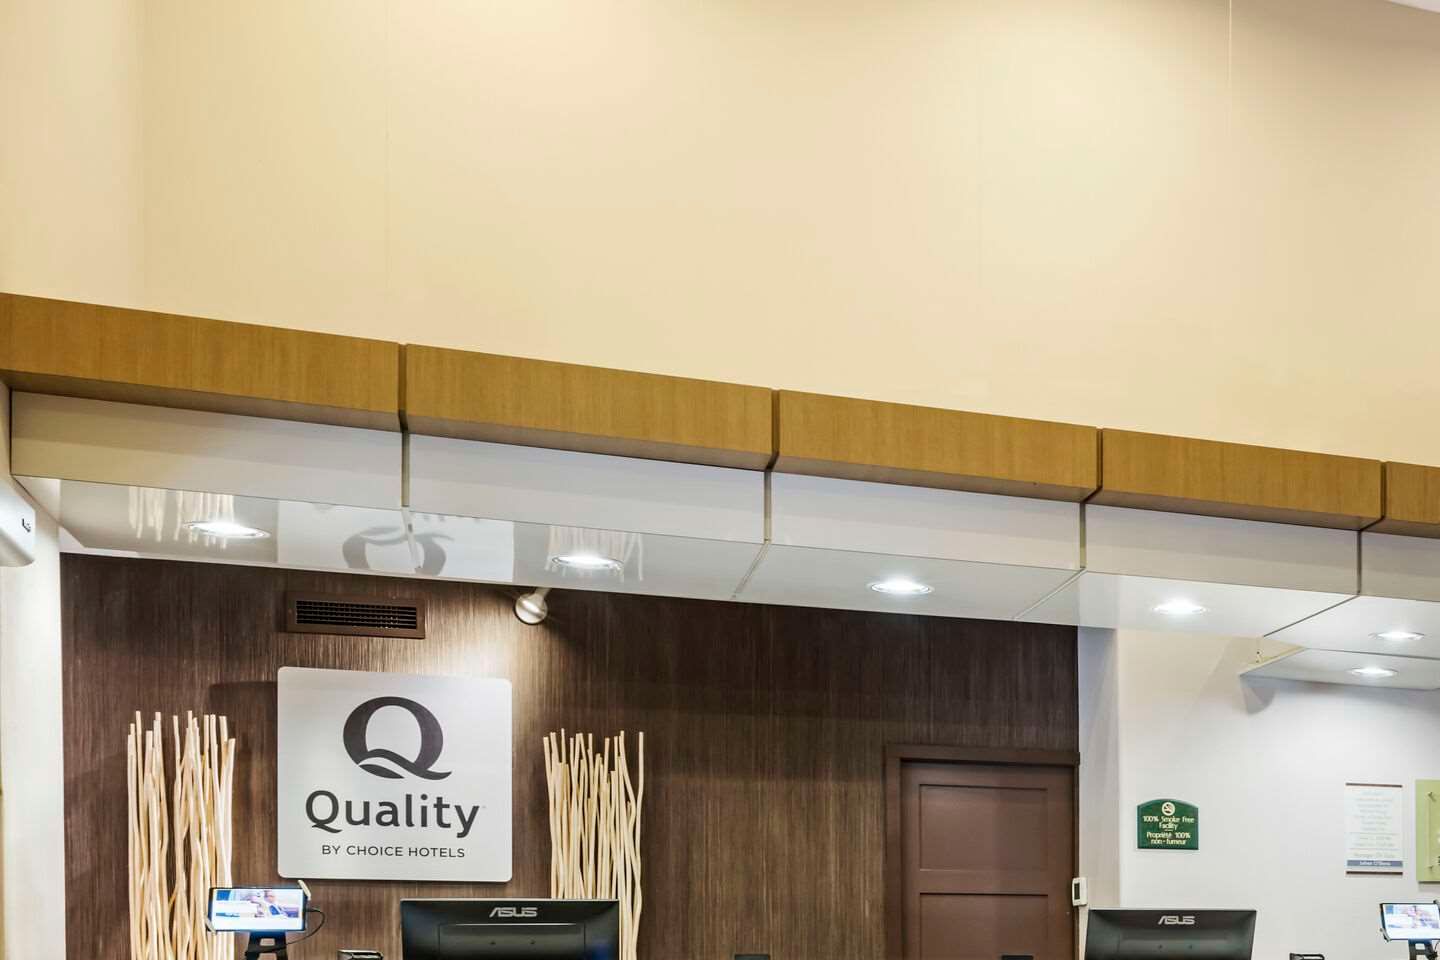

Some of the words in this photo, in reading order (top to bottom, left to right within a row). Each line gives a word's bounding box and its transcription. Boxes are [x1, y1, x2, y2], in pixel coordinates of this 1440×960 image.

[305, 789, 480, 839] Quality
[1161, 815, 1181, 823] Smoke
[321, 844, 341, 856] BY
[346, 845, 404, 857] CHOICE
[408, 847, 465, 858] HOTELS
[489, 906, 537, 918] ASUS
[1158, 915, 1196, 925] ASUS
